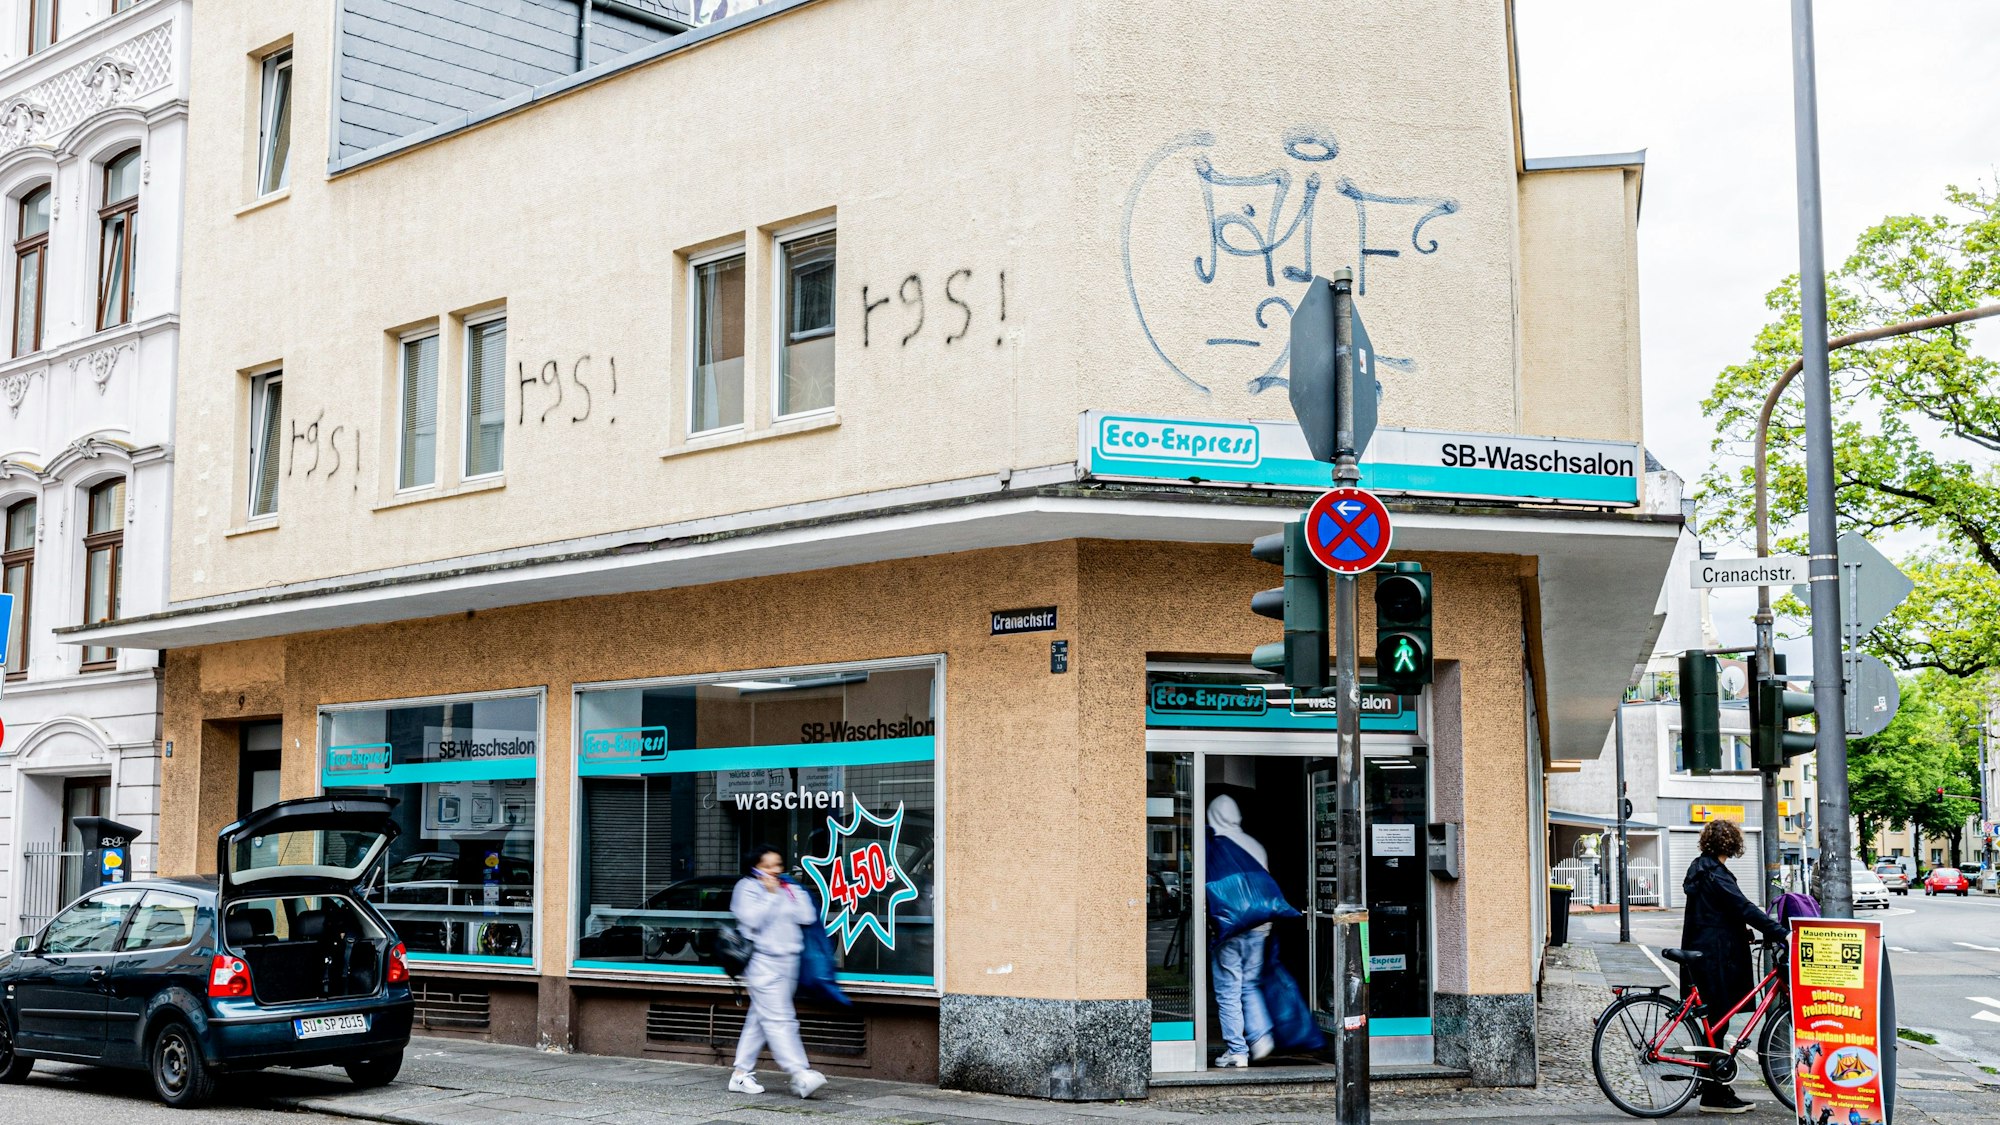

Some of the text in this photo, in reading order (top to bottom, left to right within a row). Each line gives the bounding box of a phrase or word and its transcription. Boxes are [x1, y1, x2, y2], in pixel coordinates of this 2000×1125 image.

[1106, 424, 1253, 457] Eco-Express
[1441, 443, 1634, 477] SB-Waschsalon
[1702, 565, 1796, 583] Cranachstr.
[993, 611, 1055, 631] Cranachstr.
[1156, 688, 1262, 711] Eco-Express
[1308, 694, 1391, 710] wasalon
[801, 716, 935, 744] SB-Waschsalon
[439, 736, 535, 759] SB-Waschsalon
[587, 734, 664, 760] Eco-Express
[329, 750, 389, 769] Eco-Express
[735, 785, 845, 811] waschen
[831, 843, 887, 914] 4,50
[1803, 930, 1857, 938] Mauenheim
[1369, 957, 1402, 966] -Express
[1801, 947, 1813, 958] 19
[1842, 948, 1860, 960] 05
[1811, 990, 1846, 1003] Büglers
[1801, 1002, 1863, 1020] Freizeitpark
[303, 1015, 364, 1033] SU SP 2015
[1845, 1033, 1875, 1045] Bügler
